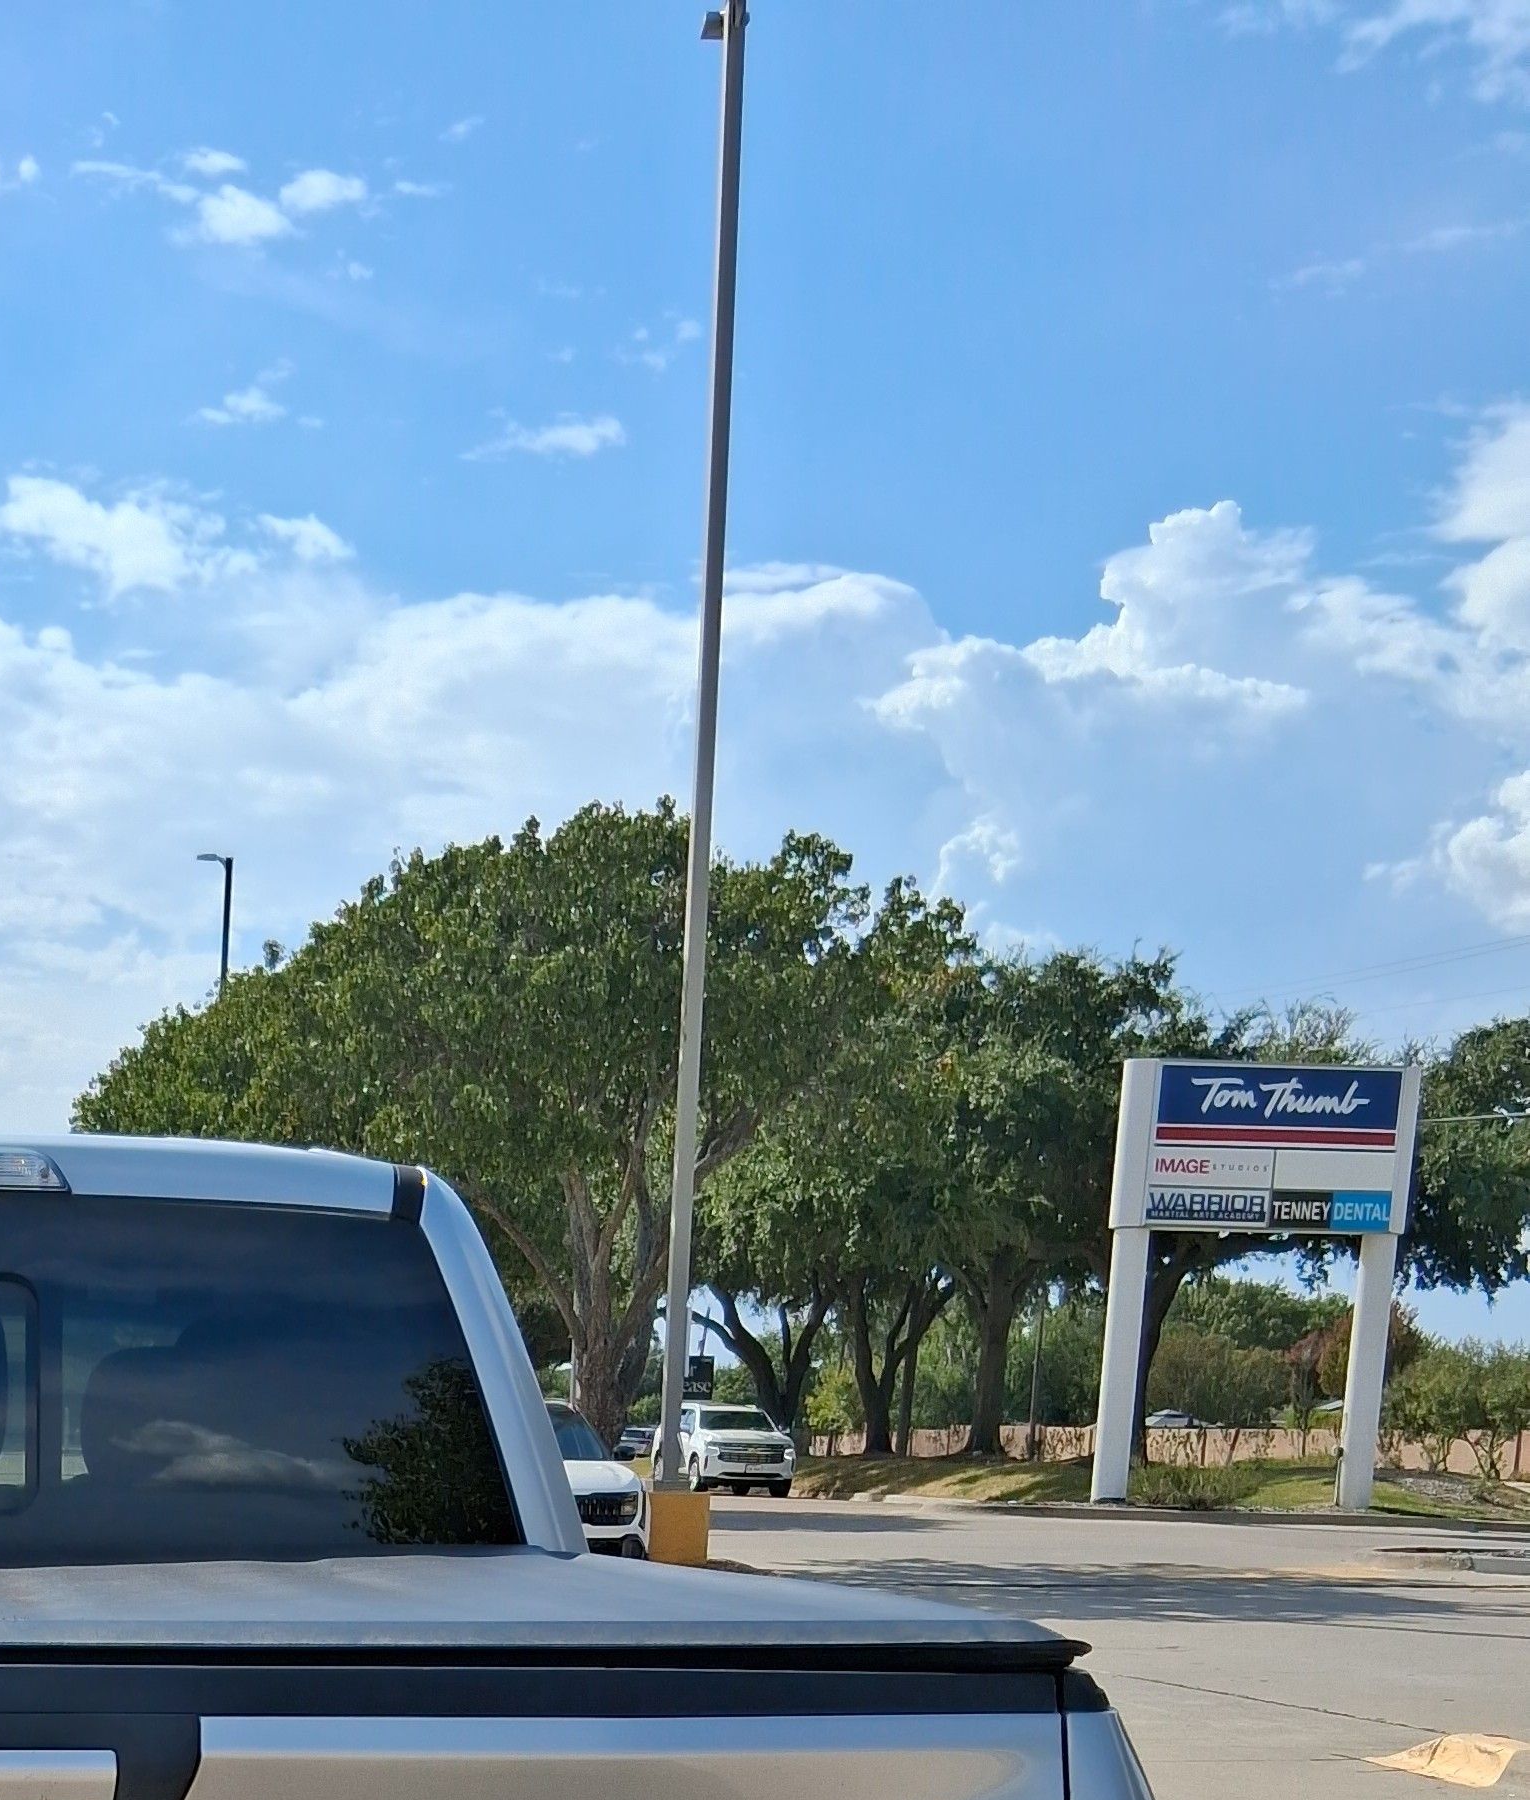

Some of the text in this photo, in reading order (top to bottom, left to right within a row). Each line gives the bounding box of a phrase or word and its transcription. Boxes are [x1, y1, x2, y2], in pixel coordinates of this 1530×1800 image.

[1191, 1076, 1371, 1119] Tom Thumb
[1155, 1158, 1269, 1174] IMAGE STUDIOS
[1150, 1192, 1266, 1213] WARRIOR
[1273, 1201, 1390, 1222] TENNEY DENTAL
[1151, 1209, 1260, 1221] MARTIAL ARTS ACADEMY
